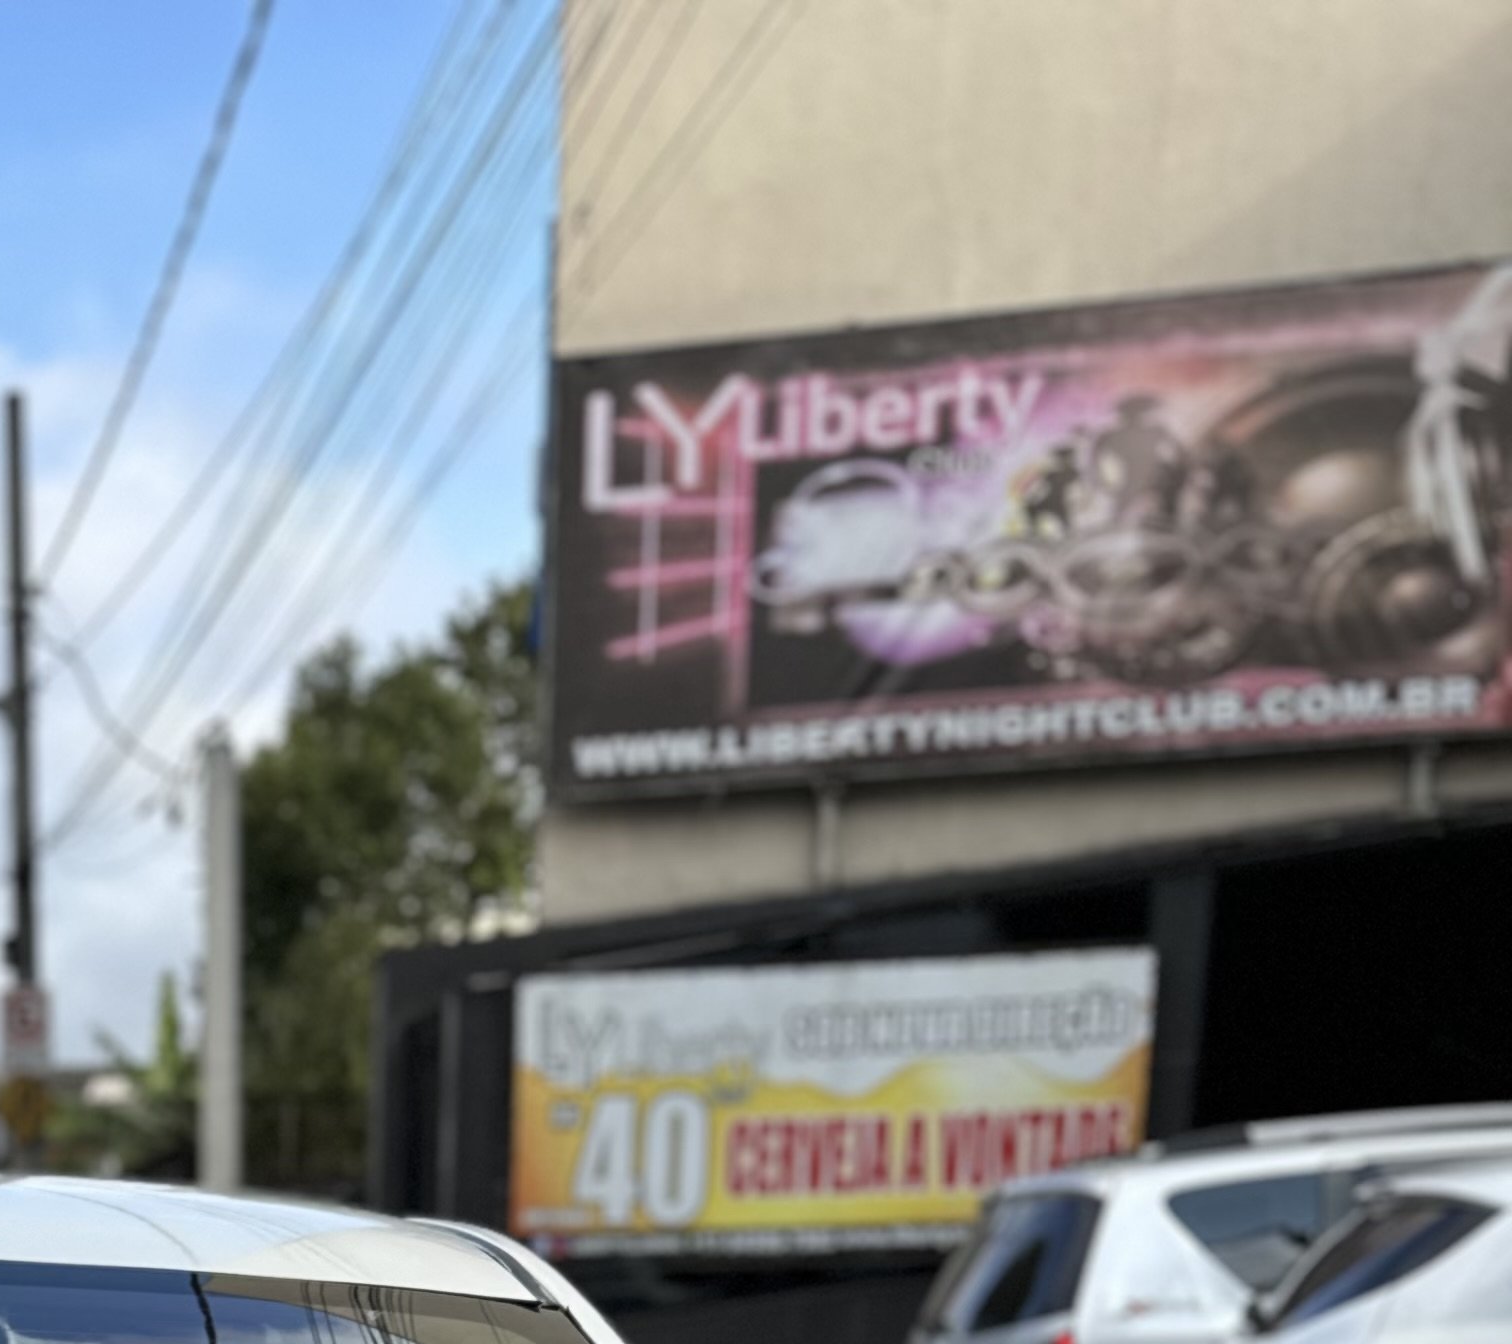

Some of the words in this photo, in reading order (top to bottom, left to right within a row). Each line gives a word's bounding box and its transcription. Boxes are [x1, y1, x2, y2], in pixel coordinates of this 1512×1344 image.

[583, 373, 749, 514] LY
[740, 367, 1046, 461] Liberty
[572, 676, 1482, 777] WWW.LIBERTYNIGHTCLUB.COM.BR
[572, 1090, 709, 1230] 40
[726, 1115, 888, 1197] CERVEJA
